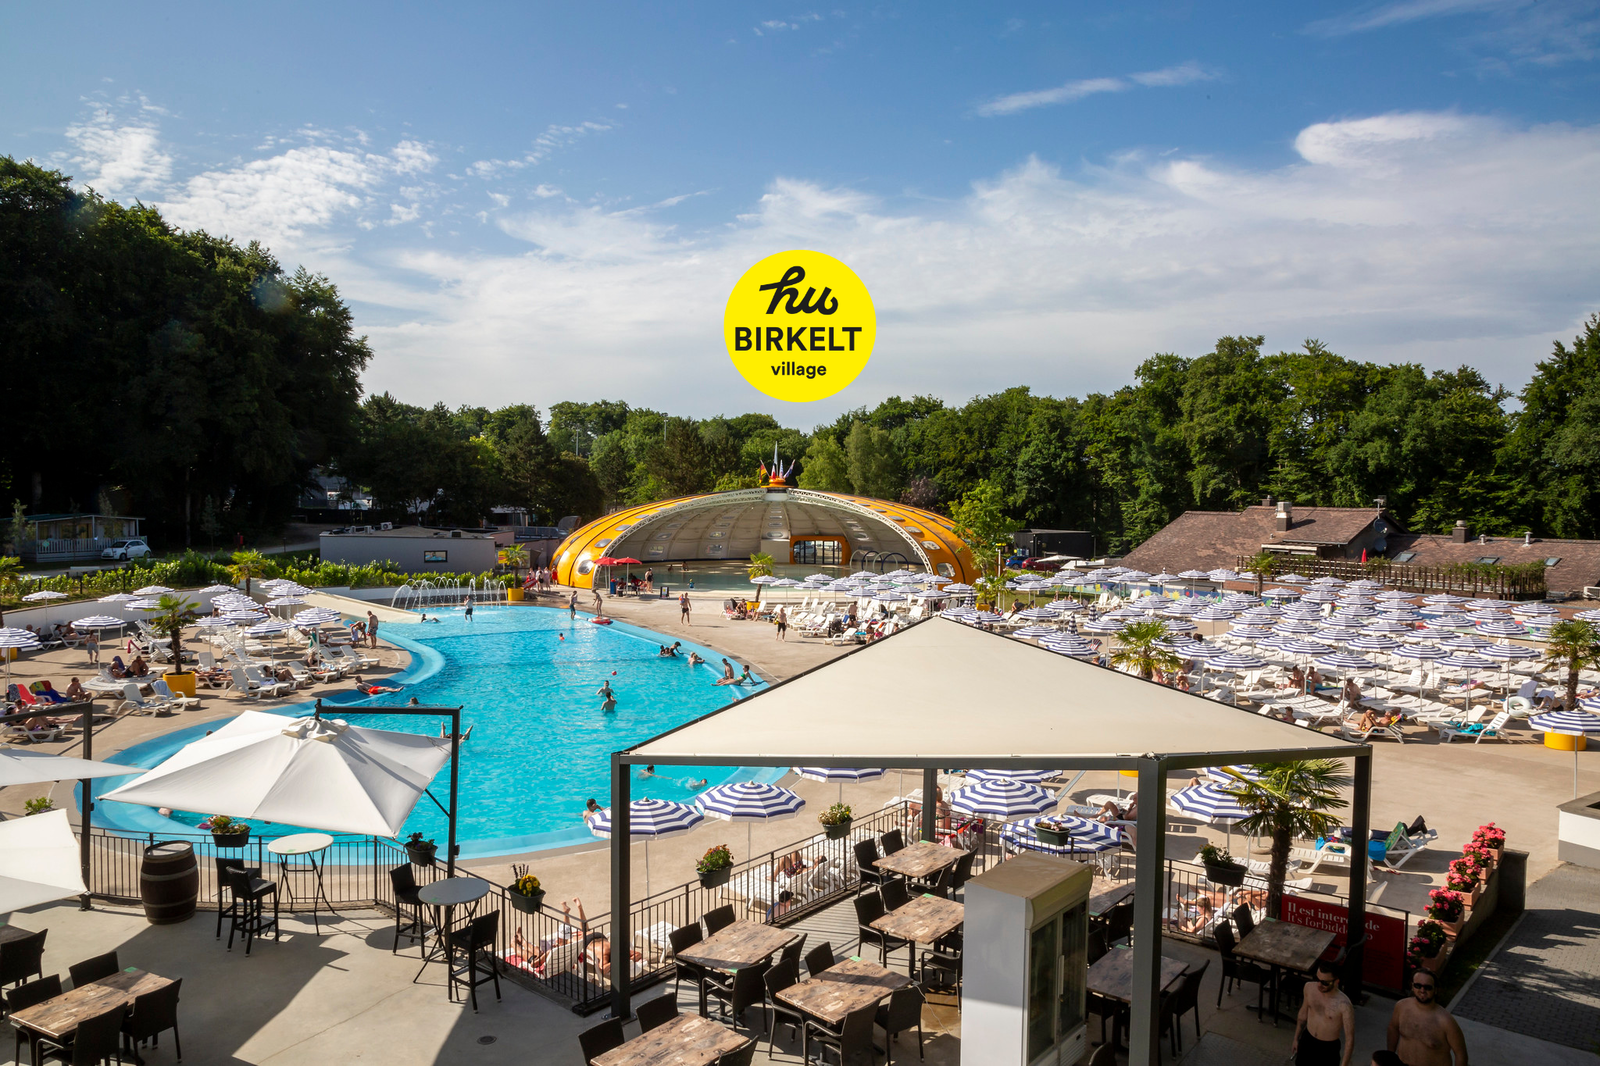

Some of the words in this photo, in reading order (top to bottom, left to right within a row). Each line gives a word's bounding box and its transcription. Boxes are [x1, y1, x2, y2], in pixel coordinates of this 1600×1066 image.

[1287, 911, 1303, 924] It's
[1305, 916, 1348, 934] forbidd
[1288, 902, 1296, 913] Il
[1299, 907, 1315, 917] est
[1365, 920, 1380, 931] de
